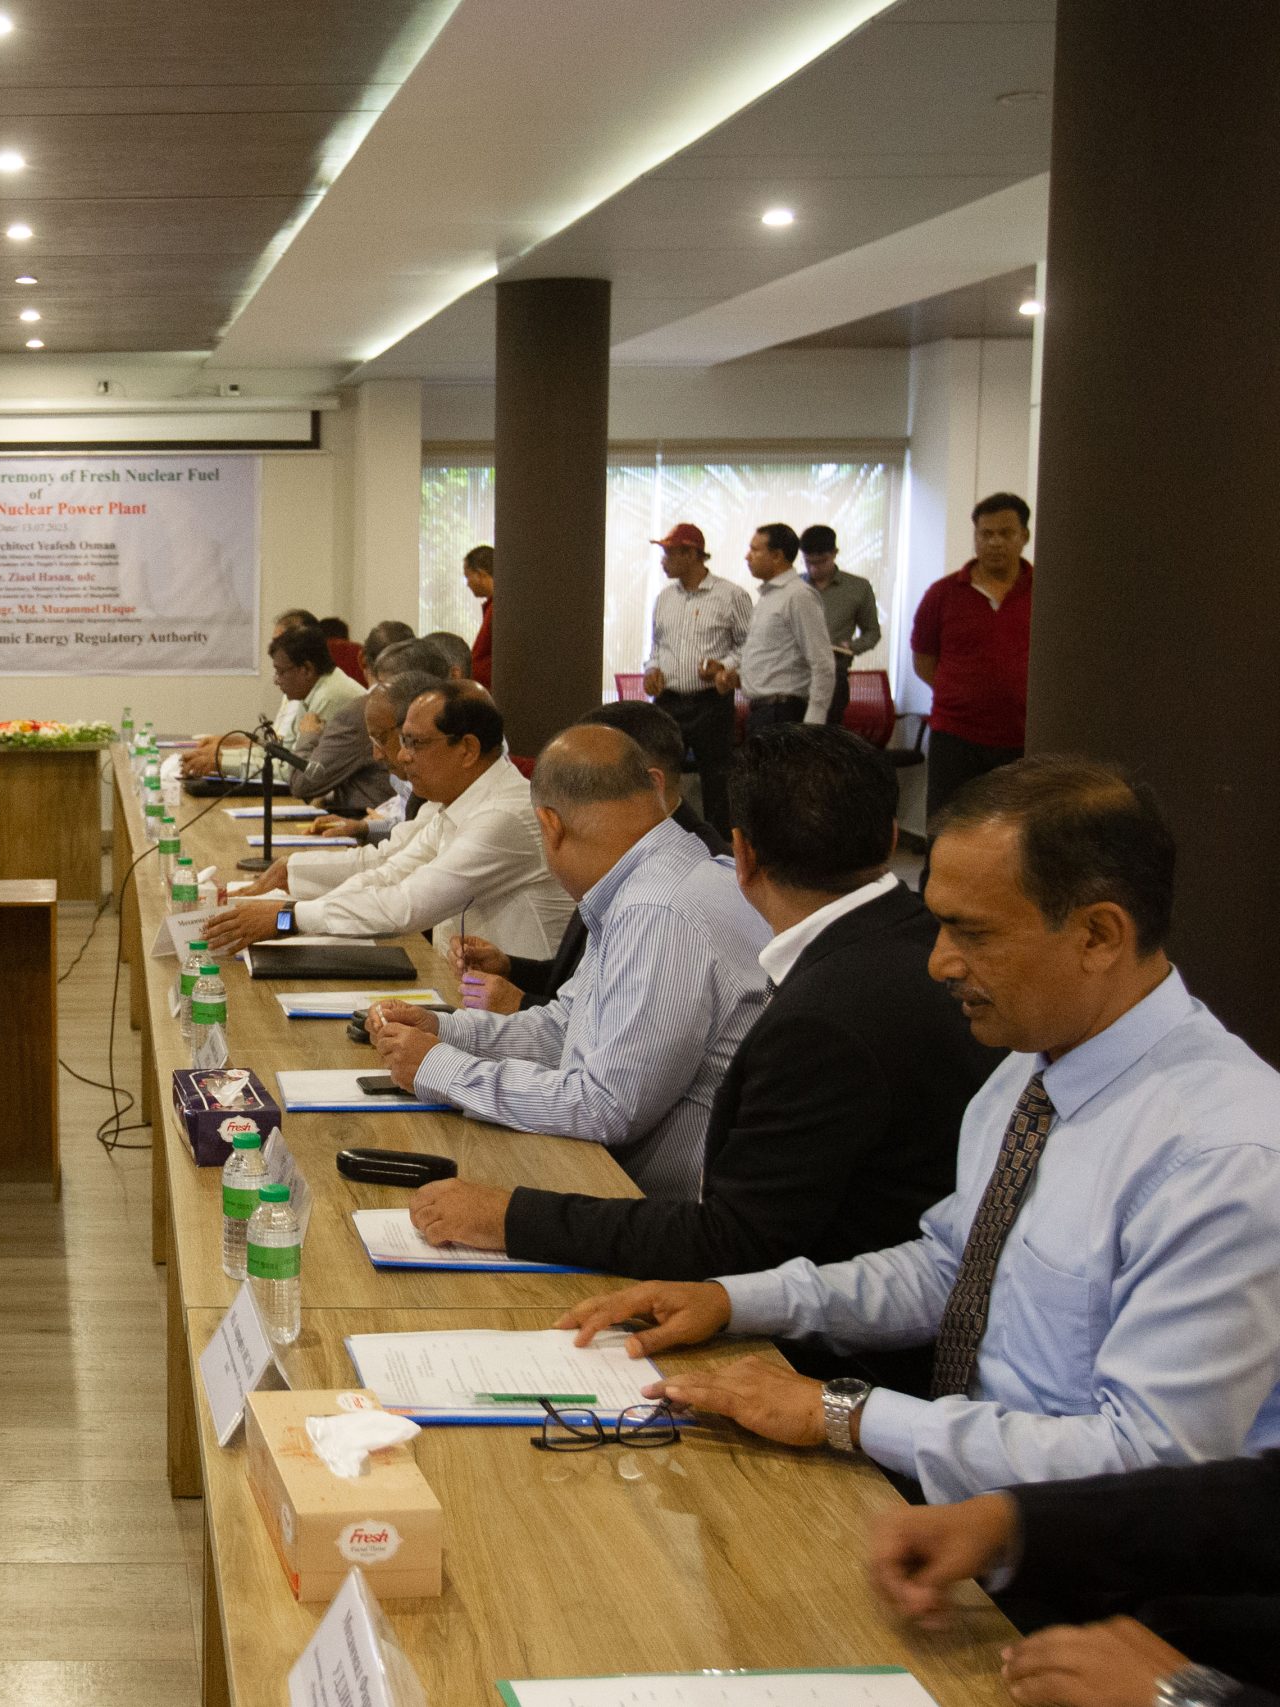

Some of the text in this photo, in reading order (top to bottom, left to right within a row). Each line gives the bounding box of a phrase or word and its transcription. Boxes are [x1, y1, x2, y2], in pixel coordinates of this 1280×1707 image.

[60, 470, 77, 483] of
[79, 469, 121, 483] Fresh
[125, 469, 184, 483] Nuclear
[187, 468, 221, 482] Fuel
[28, 488, 43, 500] of
[57, 502, 104, 516] Power
[108, 501, 147, 516] Plant
[79, 541, 117, 551] Osman
[17, 604, 38, 615] Md.
[102, 604, 137, 617] Haque
[25, 632, 70, 648] Energy
[74, 632, 144, 648] Regulatory
[148, 631, 210, 647] Authority
[226, 1121, 252, 1132] Fresh
[349, 1527, 389, 1545] Fresh
